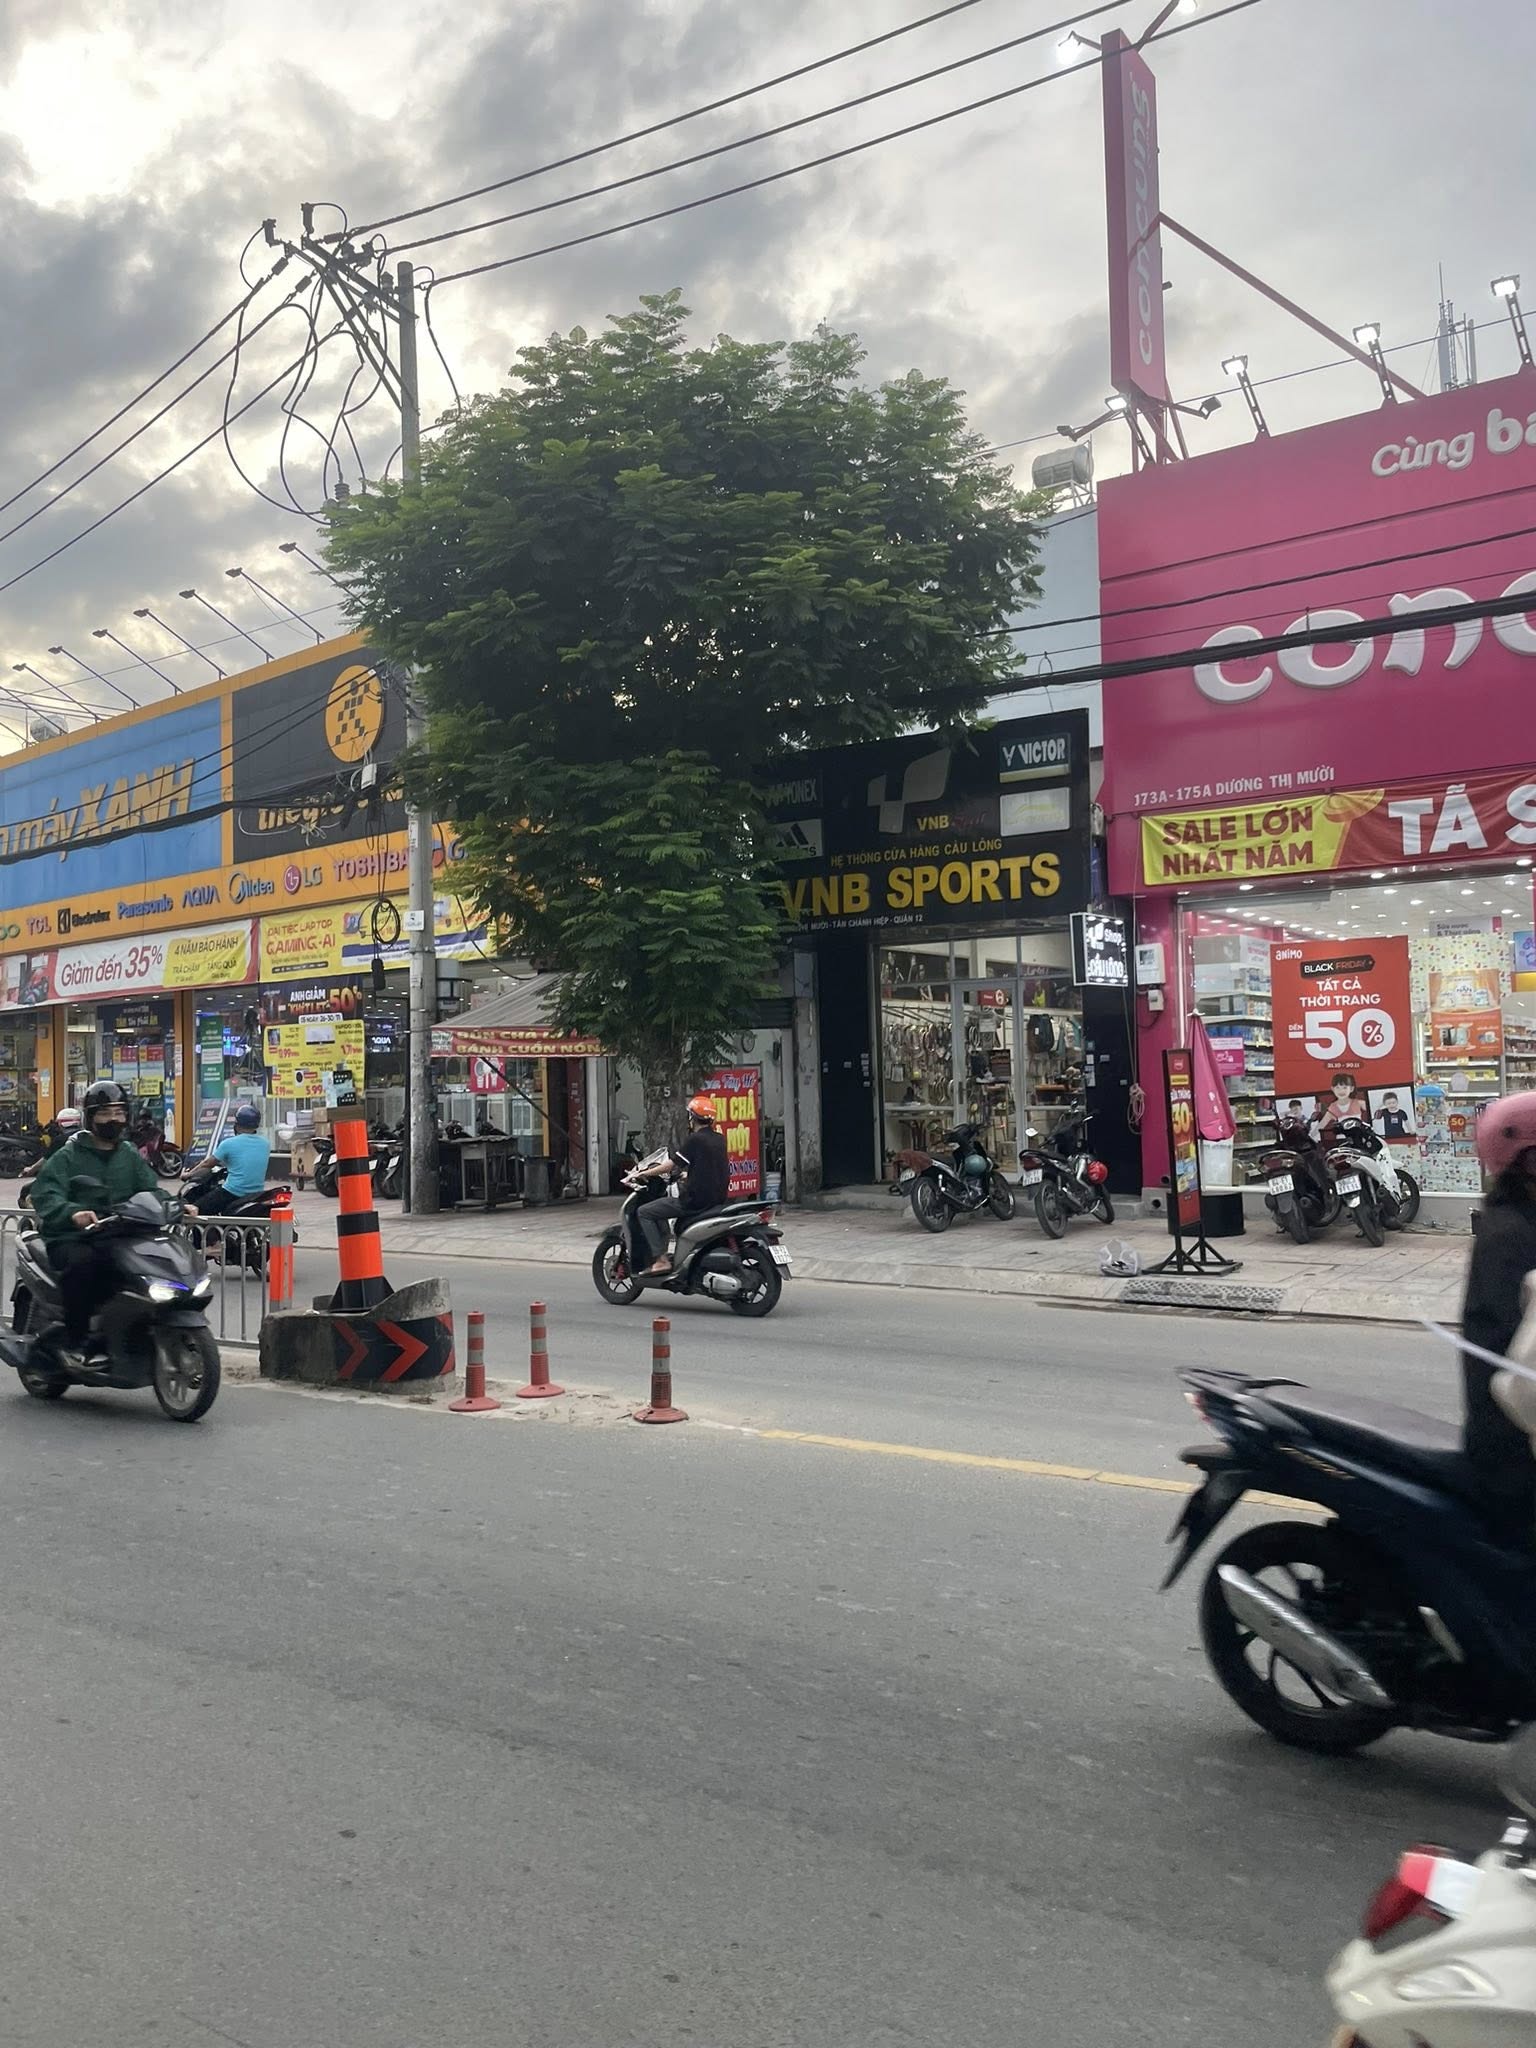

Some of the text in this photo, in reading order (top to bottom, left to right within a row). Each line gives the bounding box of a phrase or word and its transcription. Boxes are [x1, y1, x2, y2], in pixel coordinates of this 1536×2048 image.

[1371, 432, 1475, 477] Cùng
[1018, 738, 1065, 764] VICTOR
[1270, 771, 1293, 790] THỊ
[1297, 765, 1335, 785] MƯỜI
[78, 758, 196, 839] XANH
[917, 815, 949, 832] VNB
[1162, 803, 1313, 846] SALE LỚN
[1388, 783, 1489, 856] TÃ
[333, 850, 409, 883] TOSHIBA
[1162, 836, 1313, 878] NHẤT NĂM
[303, 864, 323, 887] LG
[779, 852, 1061, 921] VNB SPORTS
[117, 894, 173, 919] Panasonic
[182, 885, 220, 908] AQUA
[26, 916, 52, 936] TCL
[300, 919, 333, 932] LAPTOP
[61, 944, 163, 987] Giảm đến 35%
[1304, 960, 1366, 973] BLACK FRIDAY
[1317, 976, 1361, 991] TẤT CẢ
[1299, 994, 1381, 1007] THỜI TRANG
